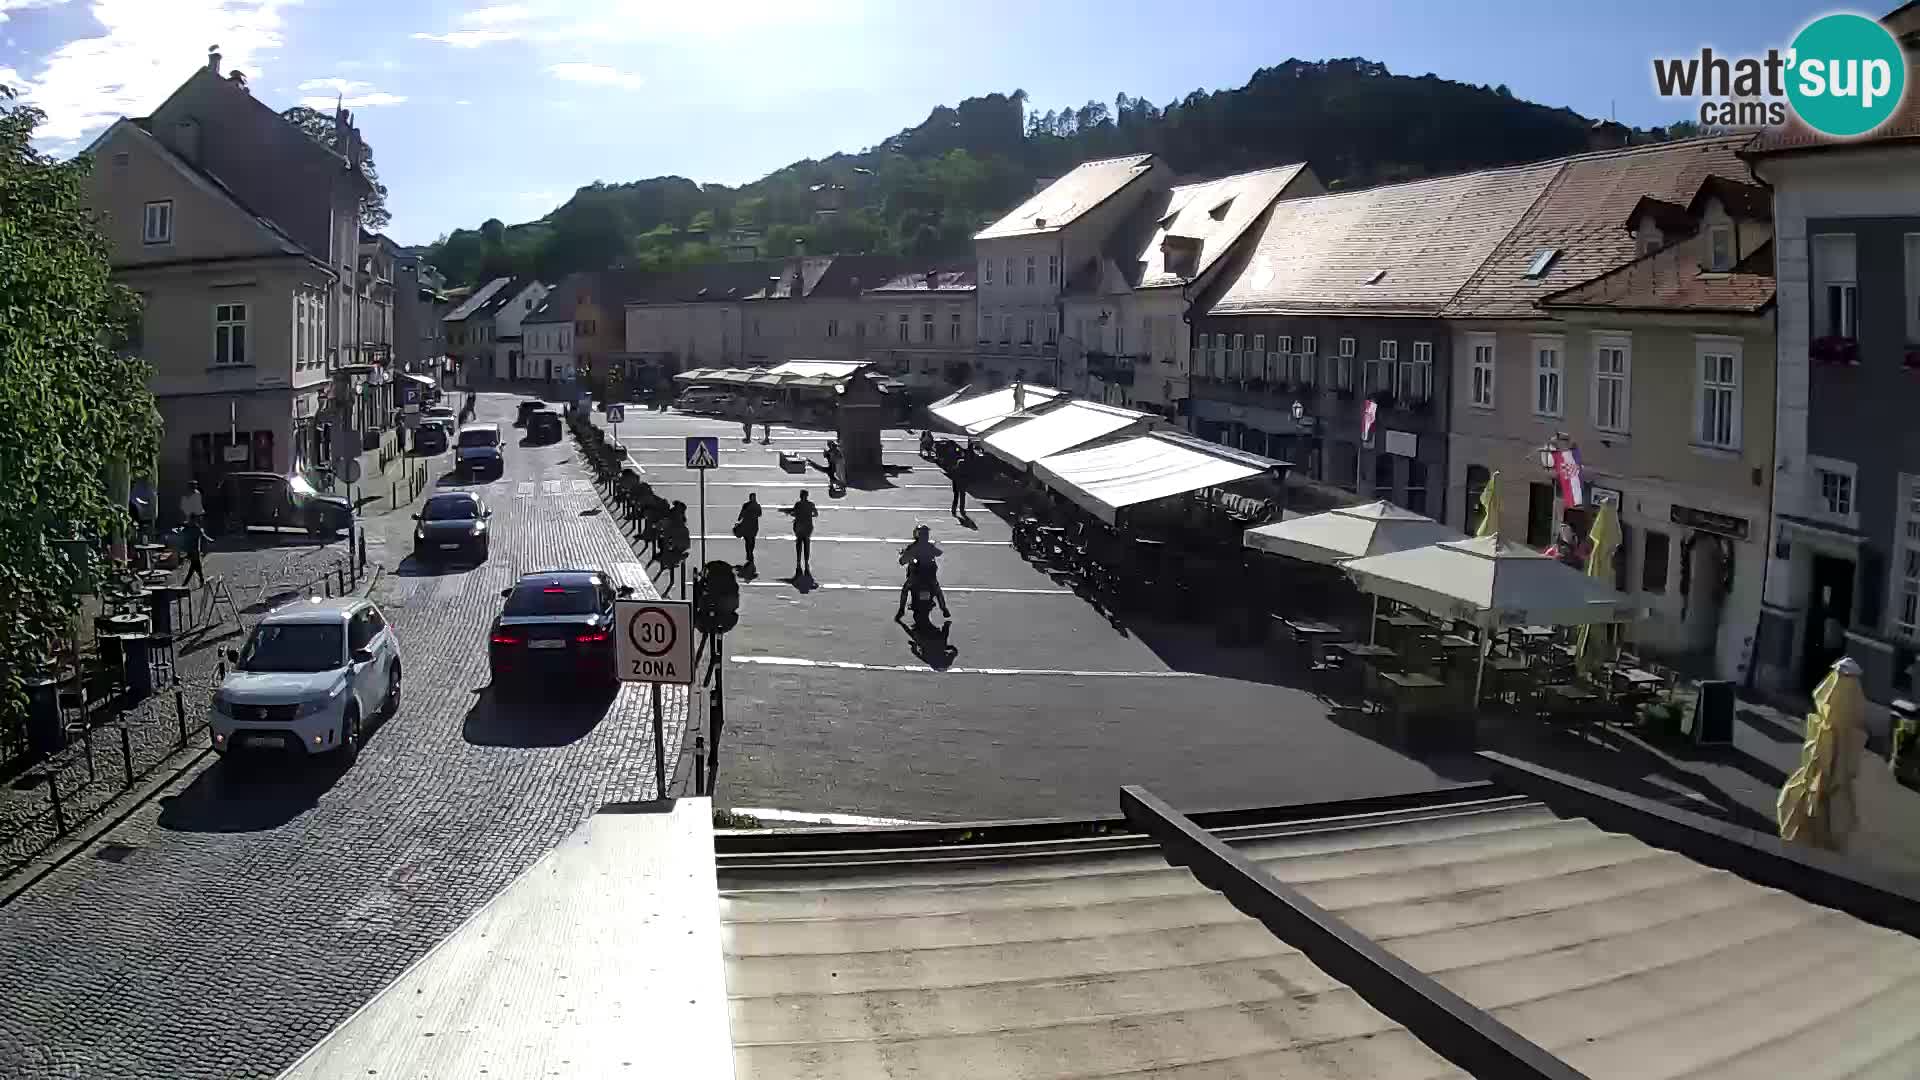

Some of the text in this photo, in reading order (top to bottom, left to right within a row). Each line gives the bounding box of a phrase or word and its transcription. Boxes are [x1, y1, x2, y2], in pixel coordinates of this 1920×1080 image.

[408, 391, 416, 401] P
[641, 623, 665, 643] 30
[632, 660, 676, 676] ZONA
